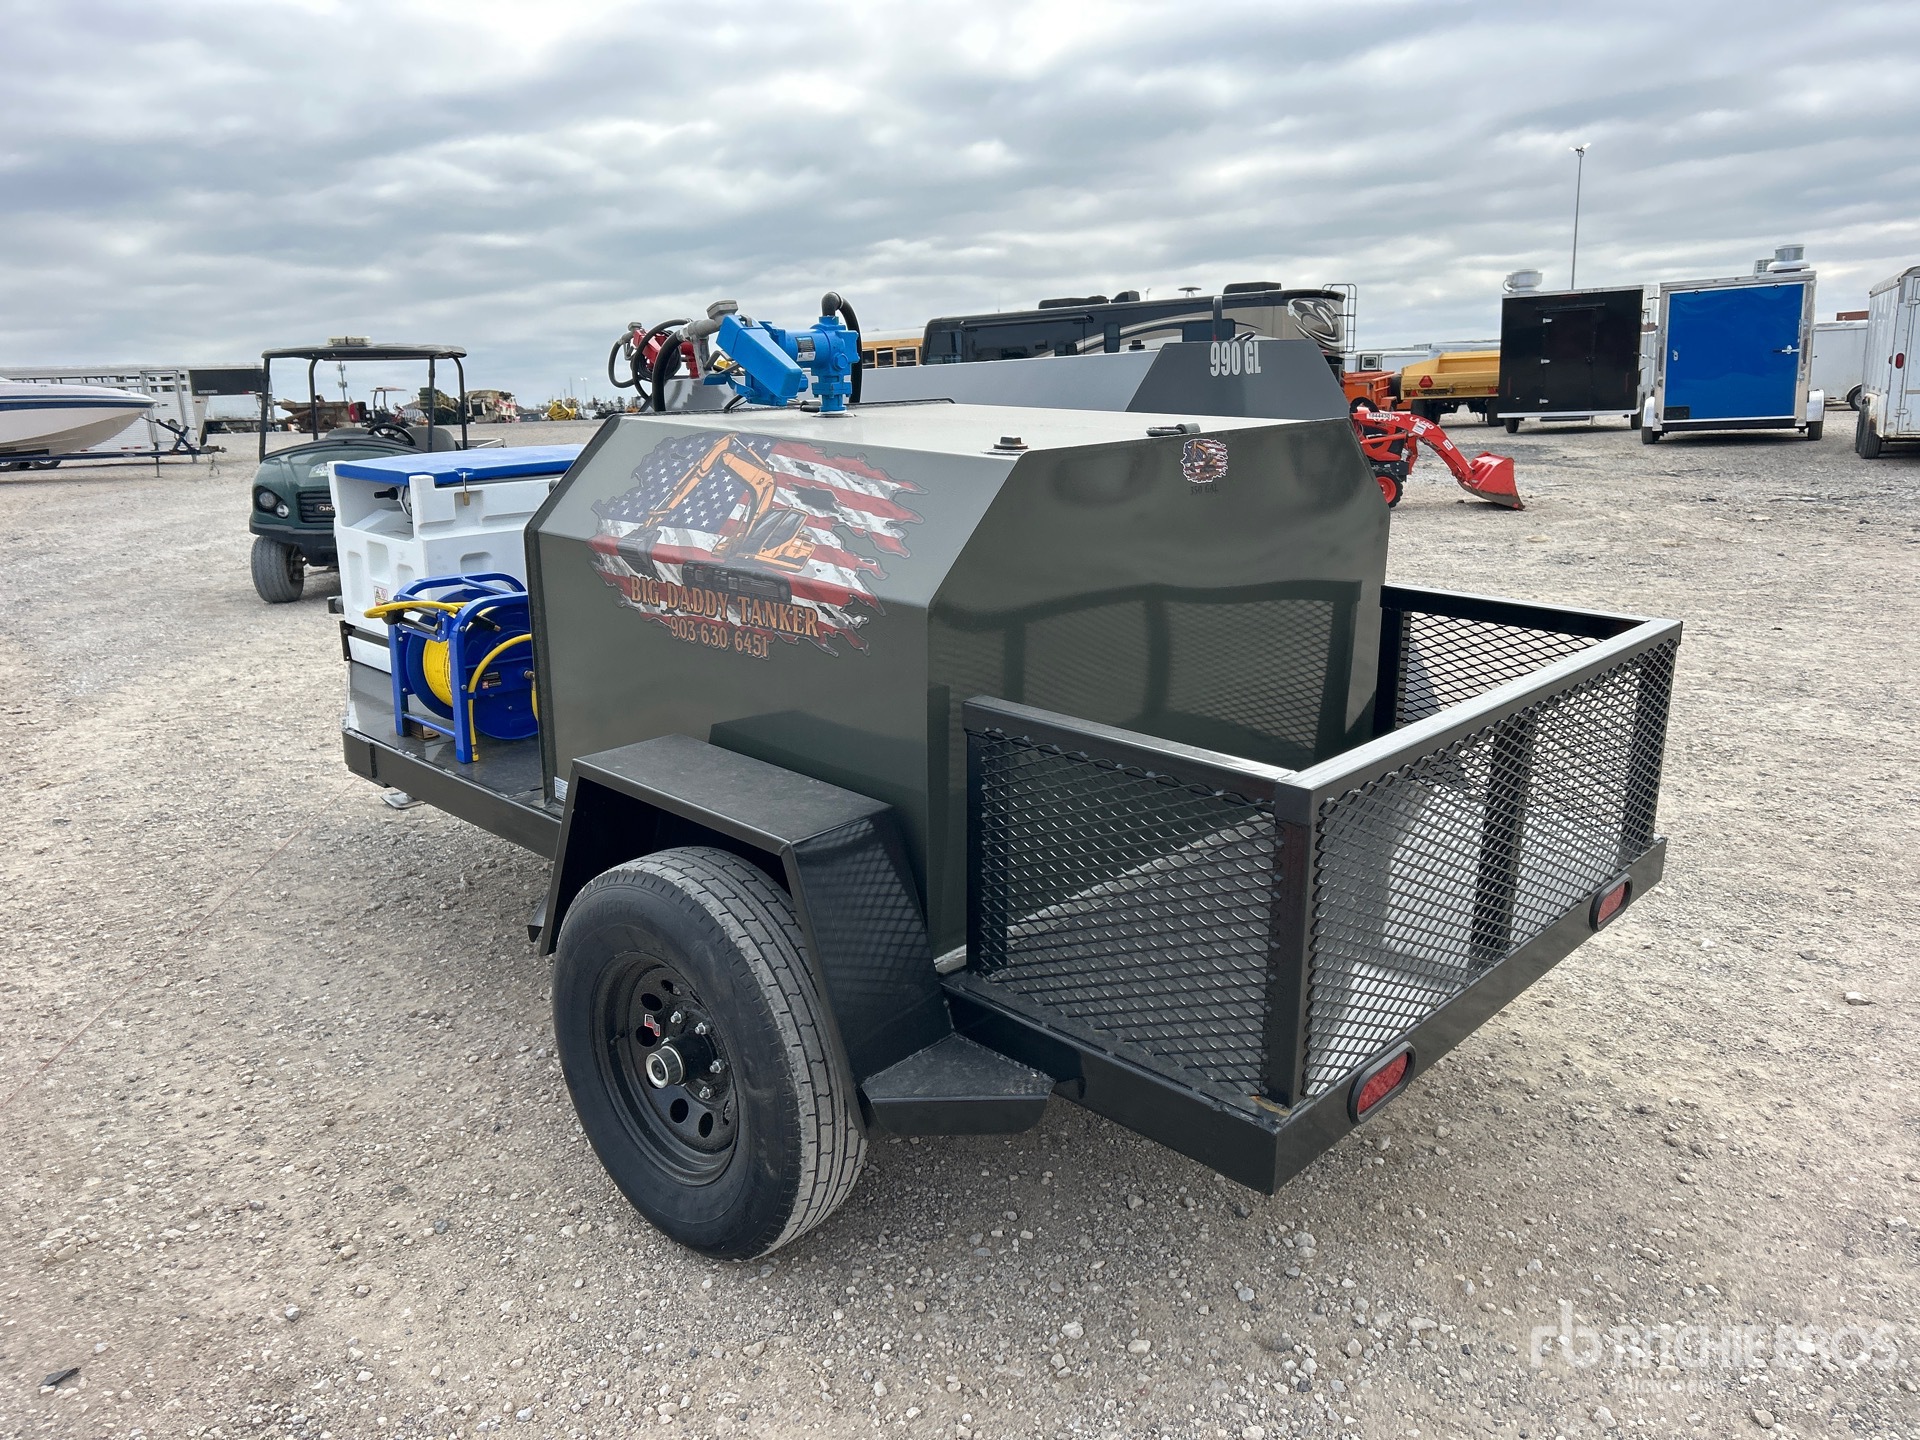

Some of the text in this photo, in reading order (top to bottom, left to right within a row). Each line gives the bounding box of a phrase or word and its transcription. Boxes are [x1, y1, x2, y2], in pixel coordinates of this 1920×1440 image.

[1210, 341, 1262, 377] 990 GL
[630, 575, 820, 638] BIG DADDY TANKER
[734, 631, 769, 659] 6451
